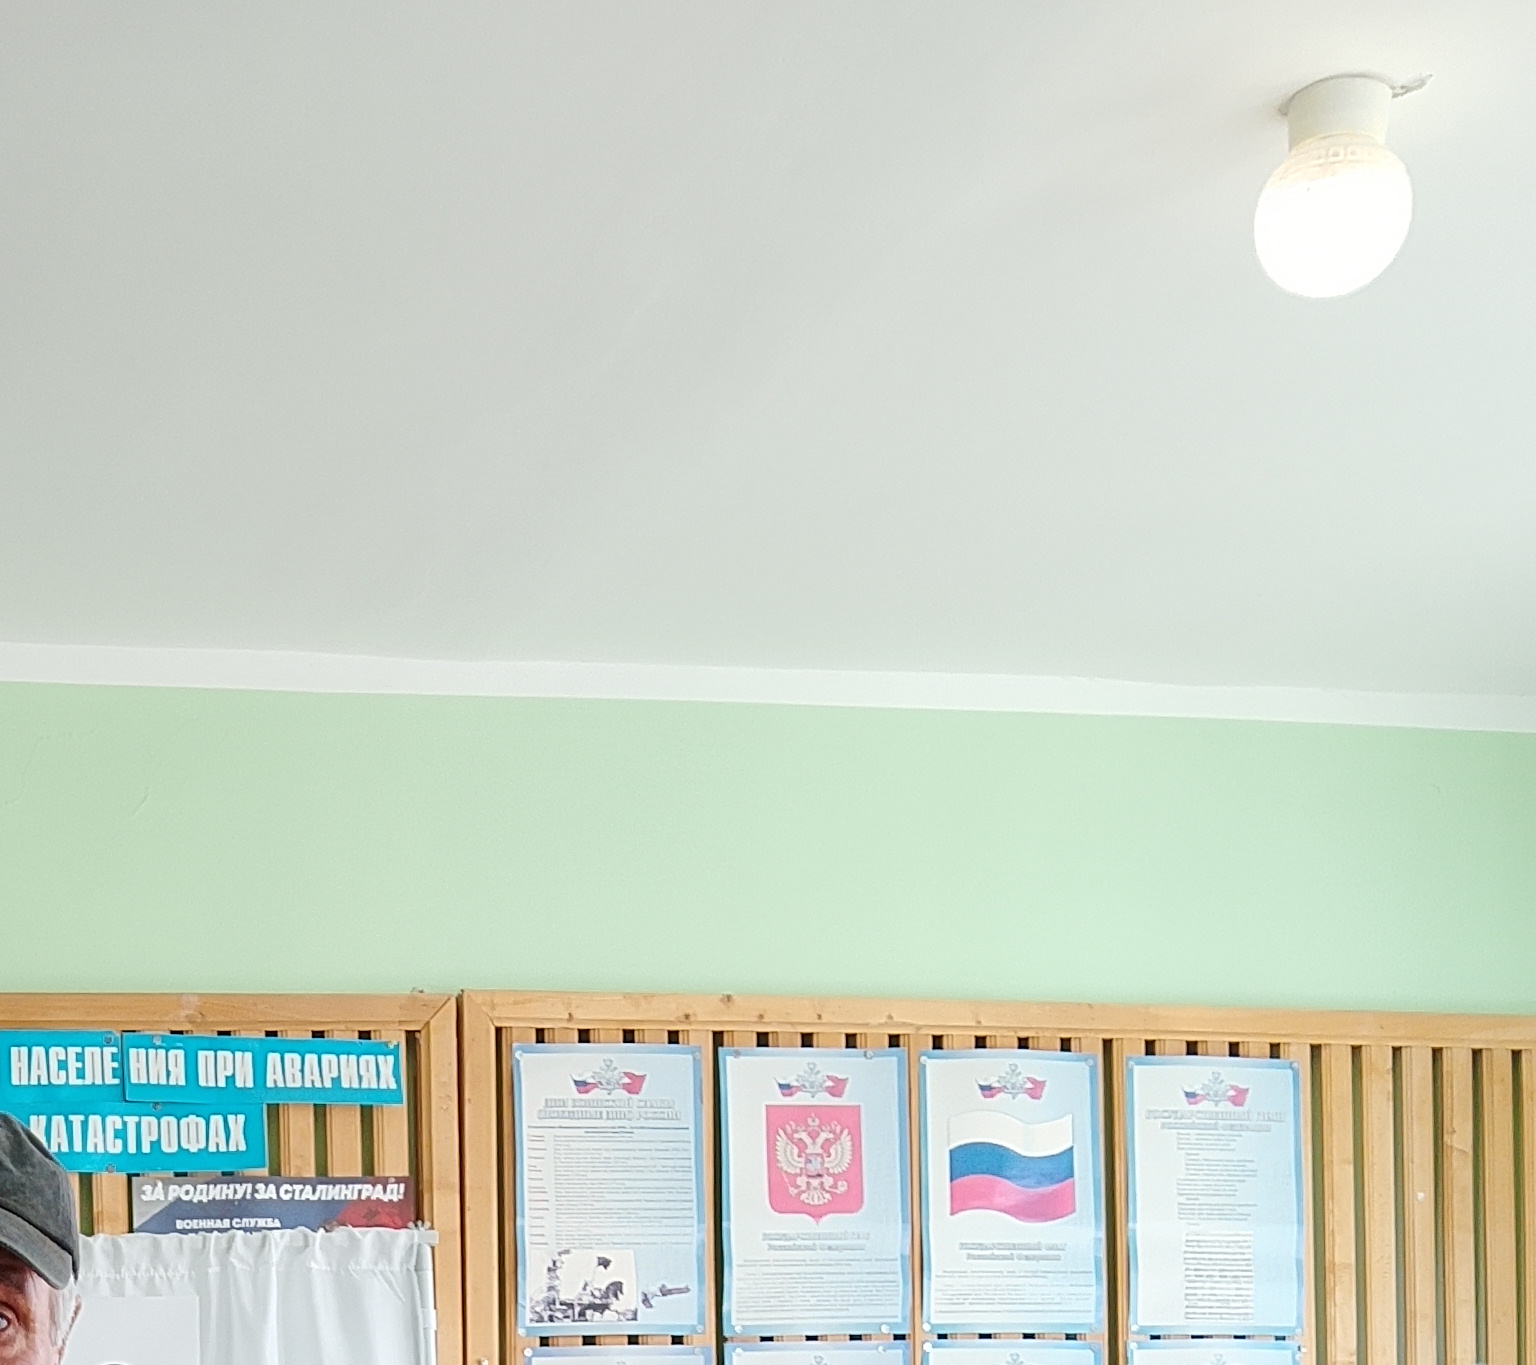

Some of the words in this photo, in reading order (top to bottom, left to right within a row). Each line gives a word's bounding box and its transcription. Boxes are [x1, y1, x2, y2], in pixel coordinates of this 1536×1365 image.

[197, 1049, 255, 1089] ПРИ
[266, 1051, 398, 1091] АВАРИЯХ
[29, 1112, 247, 1154] КАТАСТРОФАХ
[141, 1184, 165, 1201] ЗА
[168, 1183, 252, 1202] РОДИНУ!
[254, 1182, 277, 1200] ЗА
[279, 1182, 405, 1201] СТАЛИНГРАД!
[175, 1218, 230, 1229] ВОЕННАЯ
[232, 1218, 282, 1229] СЛУЖБА
